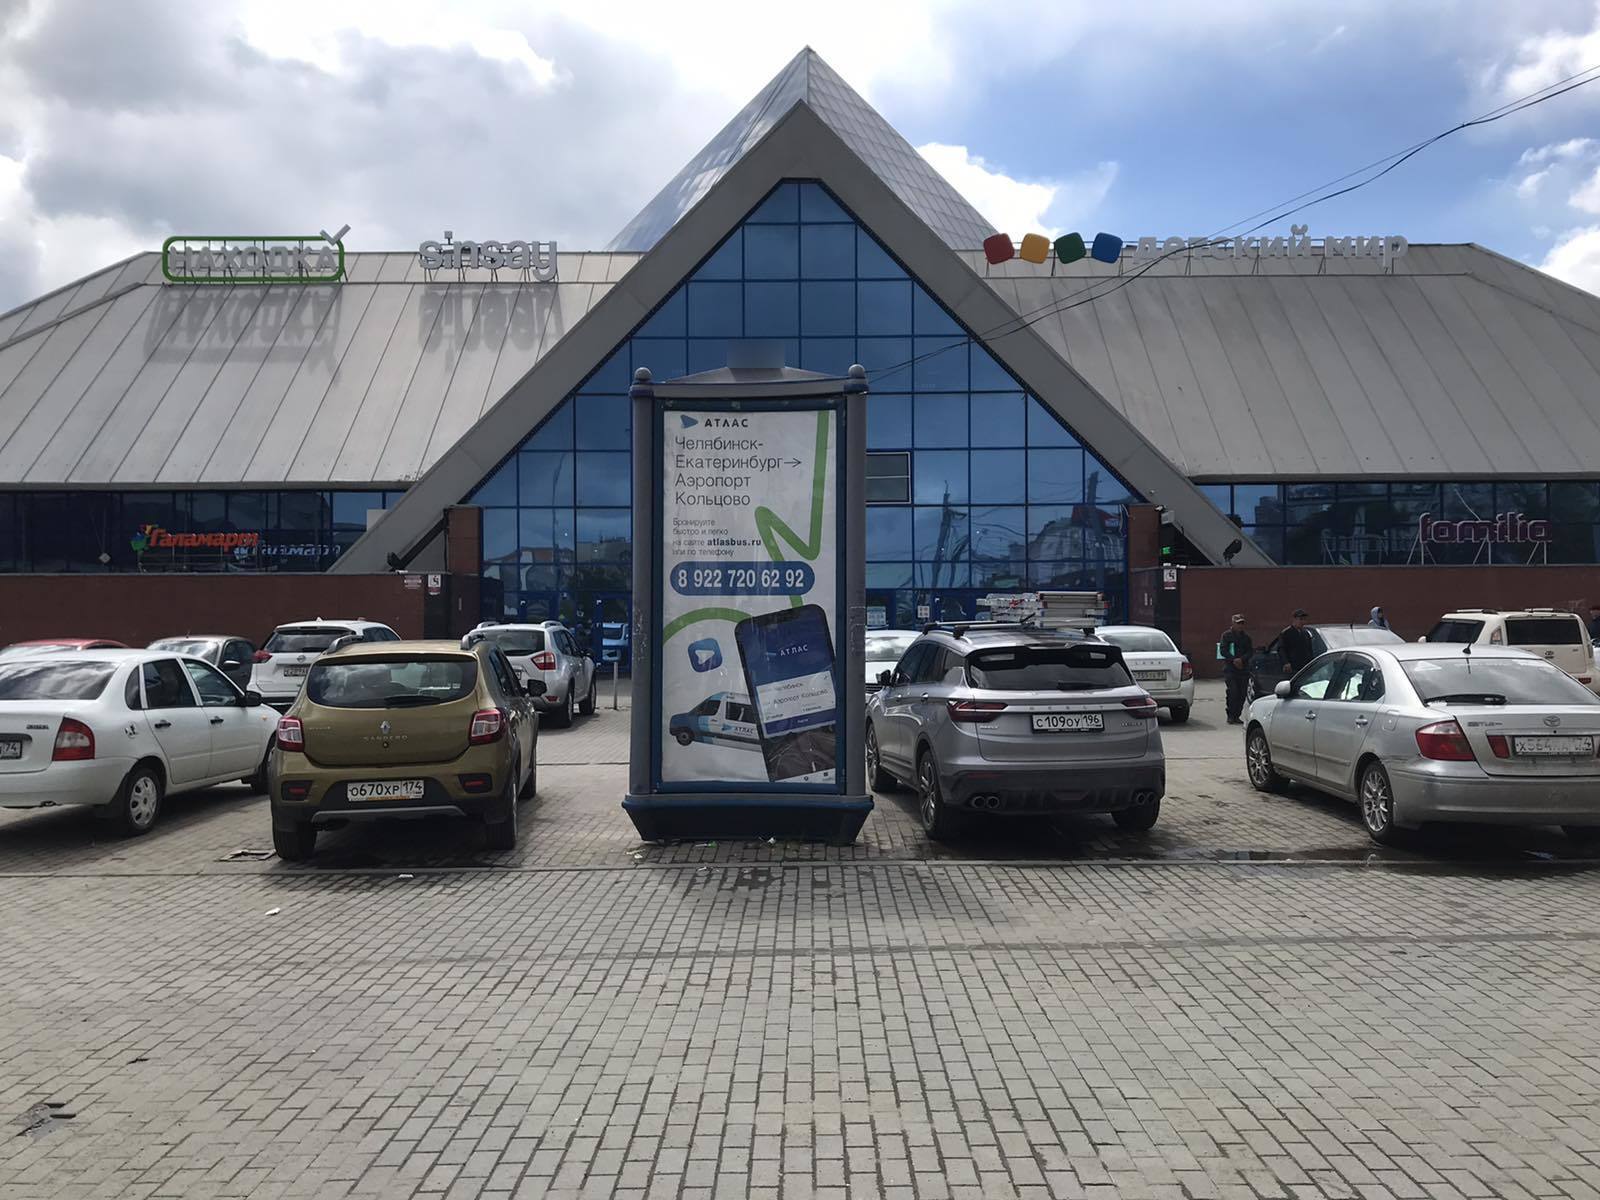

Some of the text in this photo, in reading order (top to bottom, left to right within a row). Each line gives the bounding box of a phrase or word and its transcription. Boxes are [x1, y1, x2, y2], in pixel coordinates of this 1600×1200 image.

[1132, 223, 1409, 269] детский мир
[169, 245, 338, 276] НАХОДКА
[418, 231, 558, 281] sinsay
[704, 418, 749, 428] АТЛАС
[675, 436, 764, 450] Челябинск-
[675, 454, 784, 472] Екатеринбург
[675, 473, 752, 490] Аэропорт
[675, 491, 751, 507] Кольцово
[149, 528, 260, 552] Галамарт
[707, 538, 762, 546] atlasbus.ru
[678, 569, 804, 588] 8 922 720 62 92
[780, 644, 809, 656] АТЛАС
